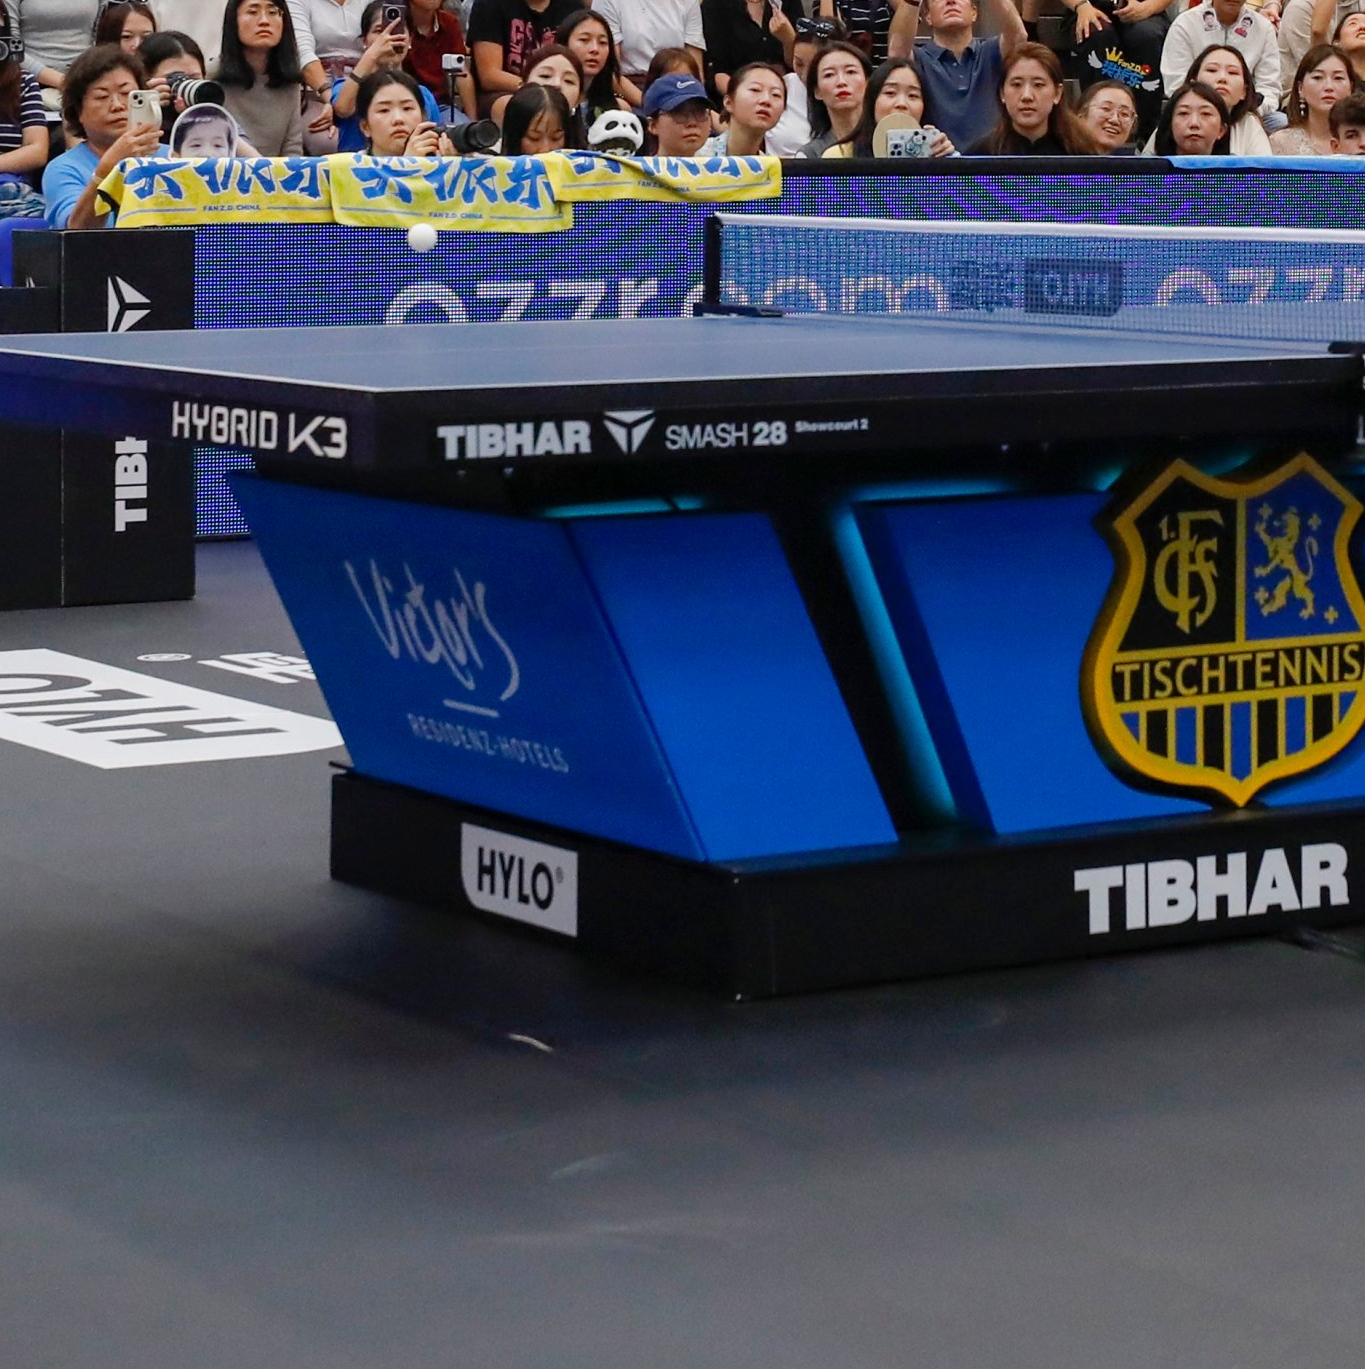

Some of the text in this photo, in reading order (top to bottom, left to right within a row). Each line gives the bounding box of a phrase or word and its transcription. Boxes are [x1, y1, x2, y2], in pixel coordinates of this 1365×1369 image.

[172, 400, 349, 460] HYBRID K3
[436, 417, 869, 460] TIBHAR SMASH 28 Showcourt 2
[1114, 643, 1363, 703] TISCHTENNIS
[406, 713, 570, 774] RESIDENZ-HOTELS
[475, 845, 555, 910] HYLO
[1073, 842, 1350, 935] TIBHAR
